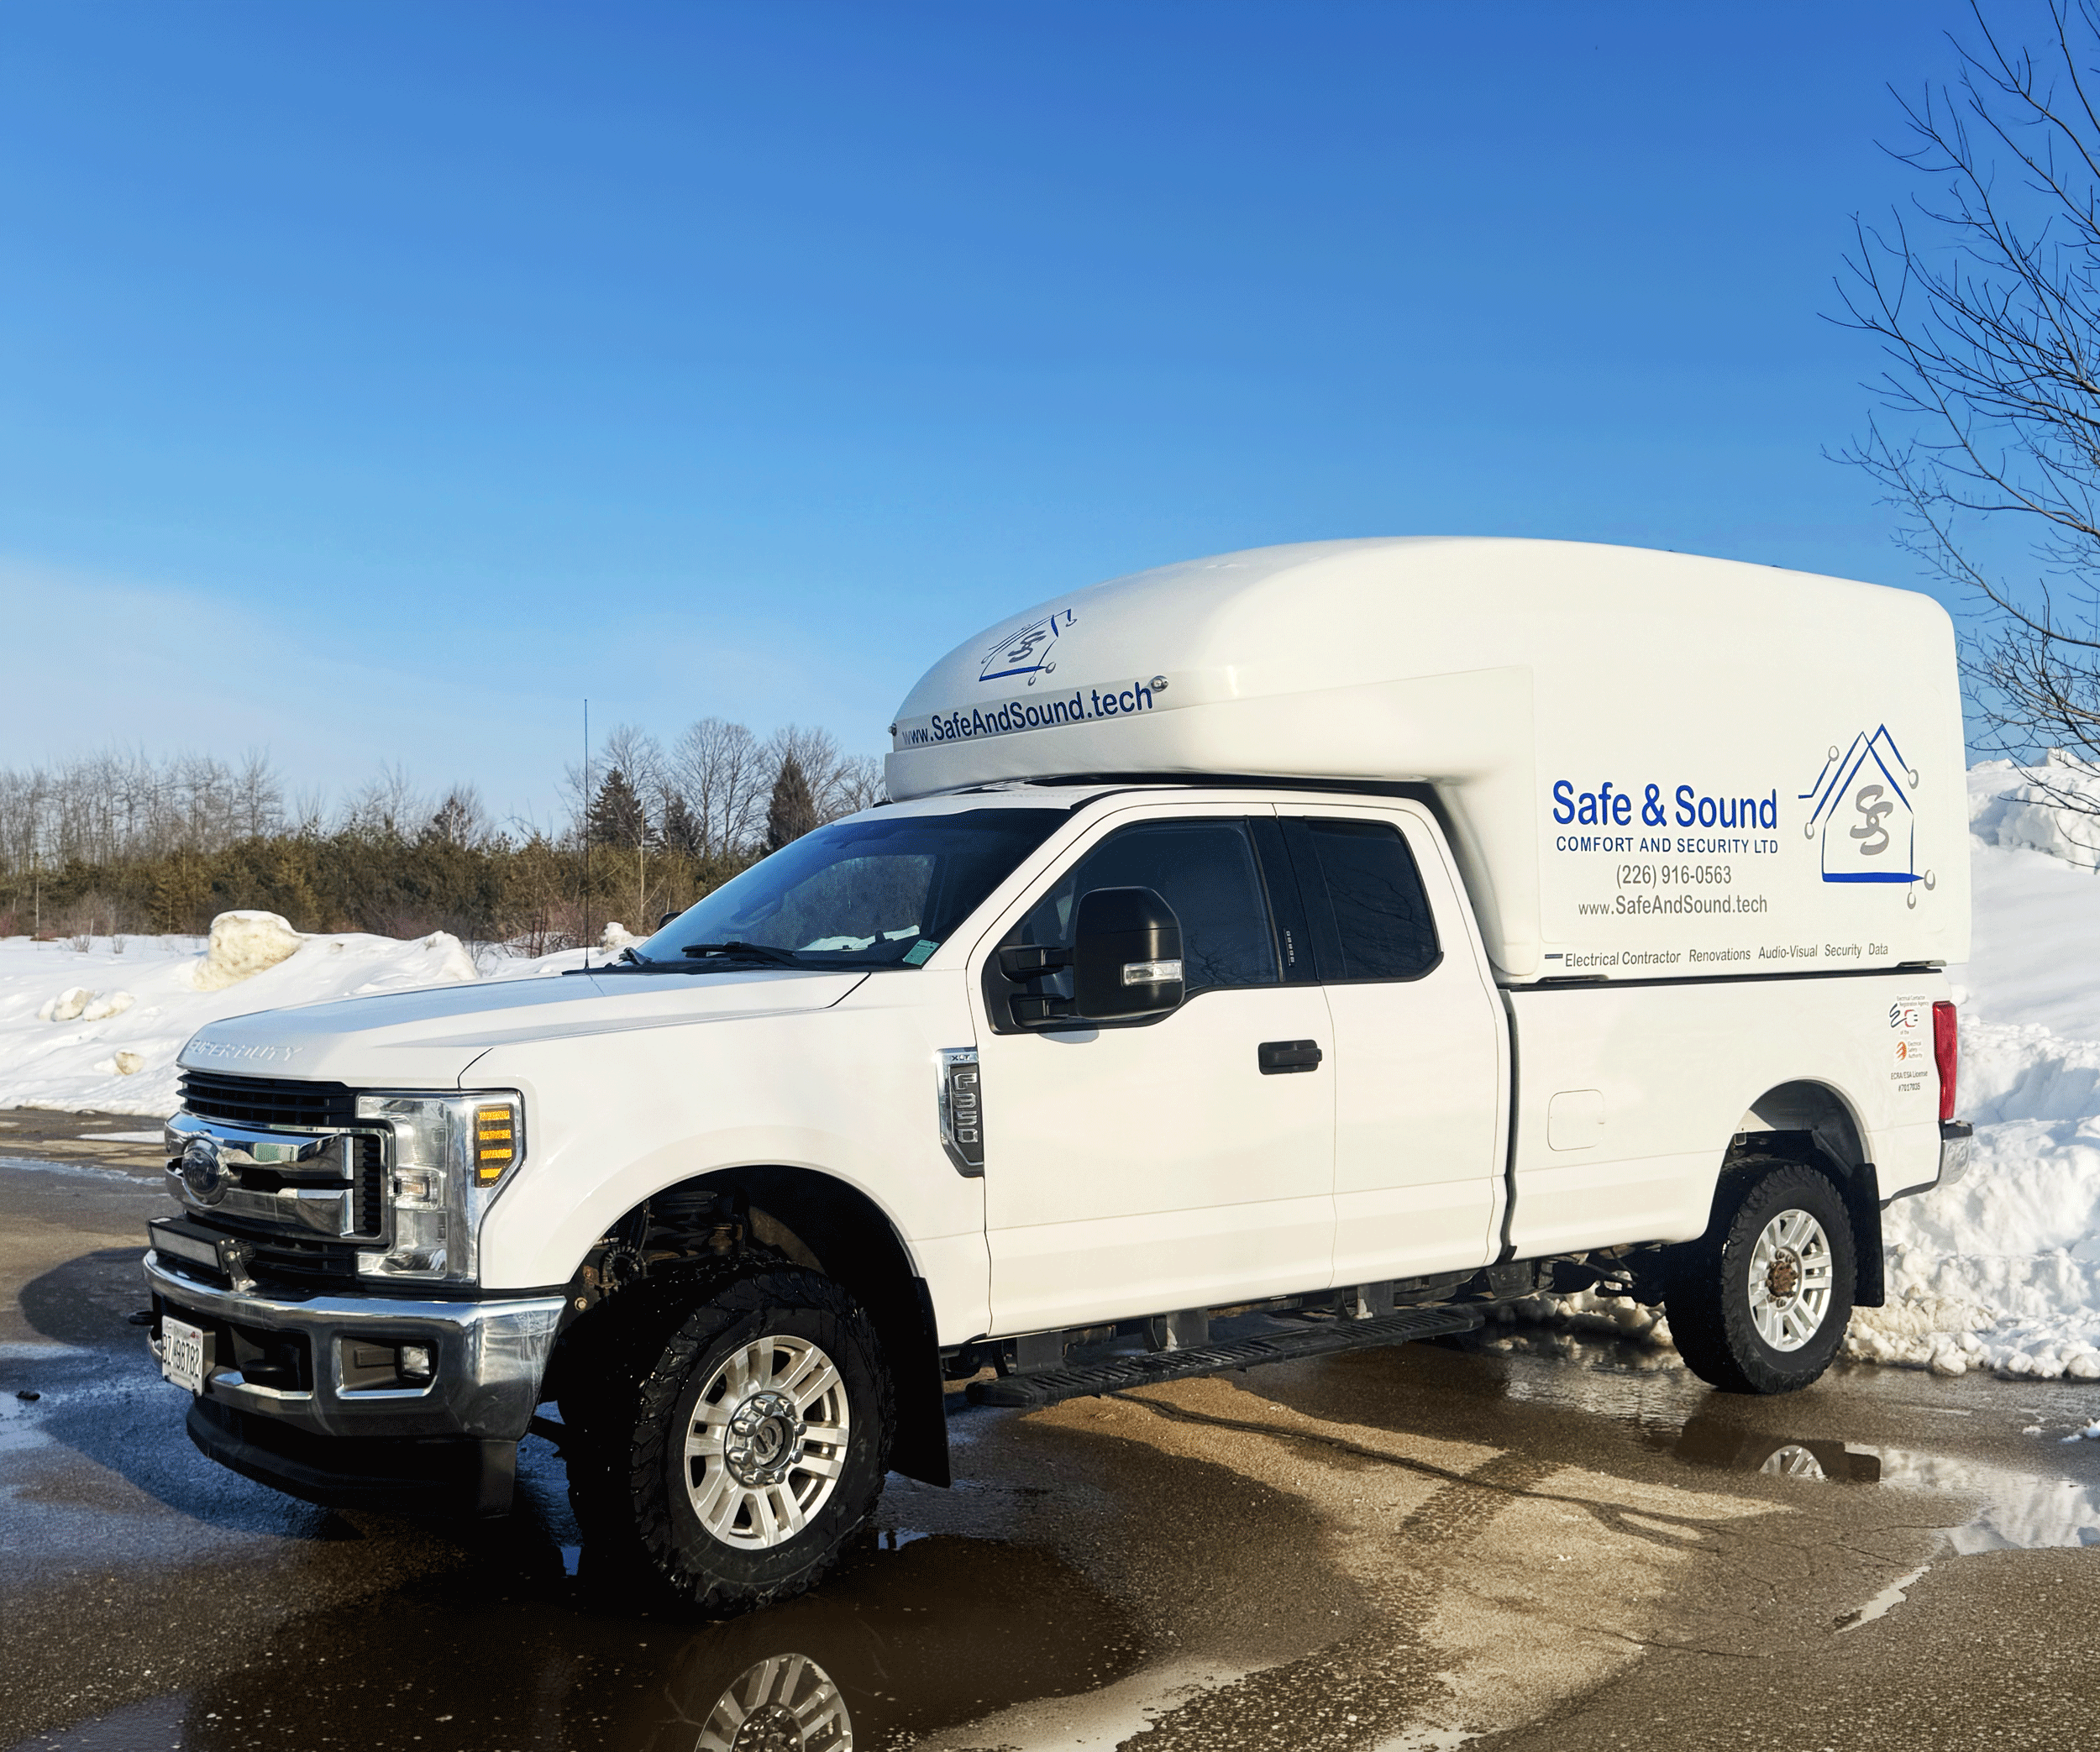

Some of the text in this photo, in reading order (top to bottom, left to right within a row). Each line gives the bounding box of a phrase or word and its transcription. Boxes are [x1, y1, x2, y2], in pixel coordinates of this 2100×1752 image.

[901, 681, 1153, 745] www.SafeAndSound.tech
[1553, 779, 1777, 830] Safe & Sound
[1557, 836, 1779, 854] COMFORT AND SECURITY LTD
[1616, 864, 1732, 889] (226) 916-0563
[1578, 894, 1768, 915] www.SafeAndSound.tech
[1565, 942, 1889, 968] Electrical Contractor Renovations Audio-Visual Security Data
